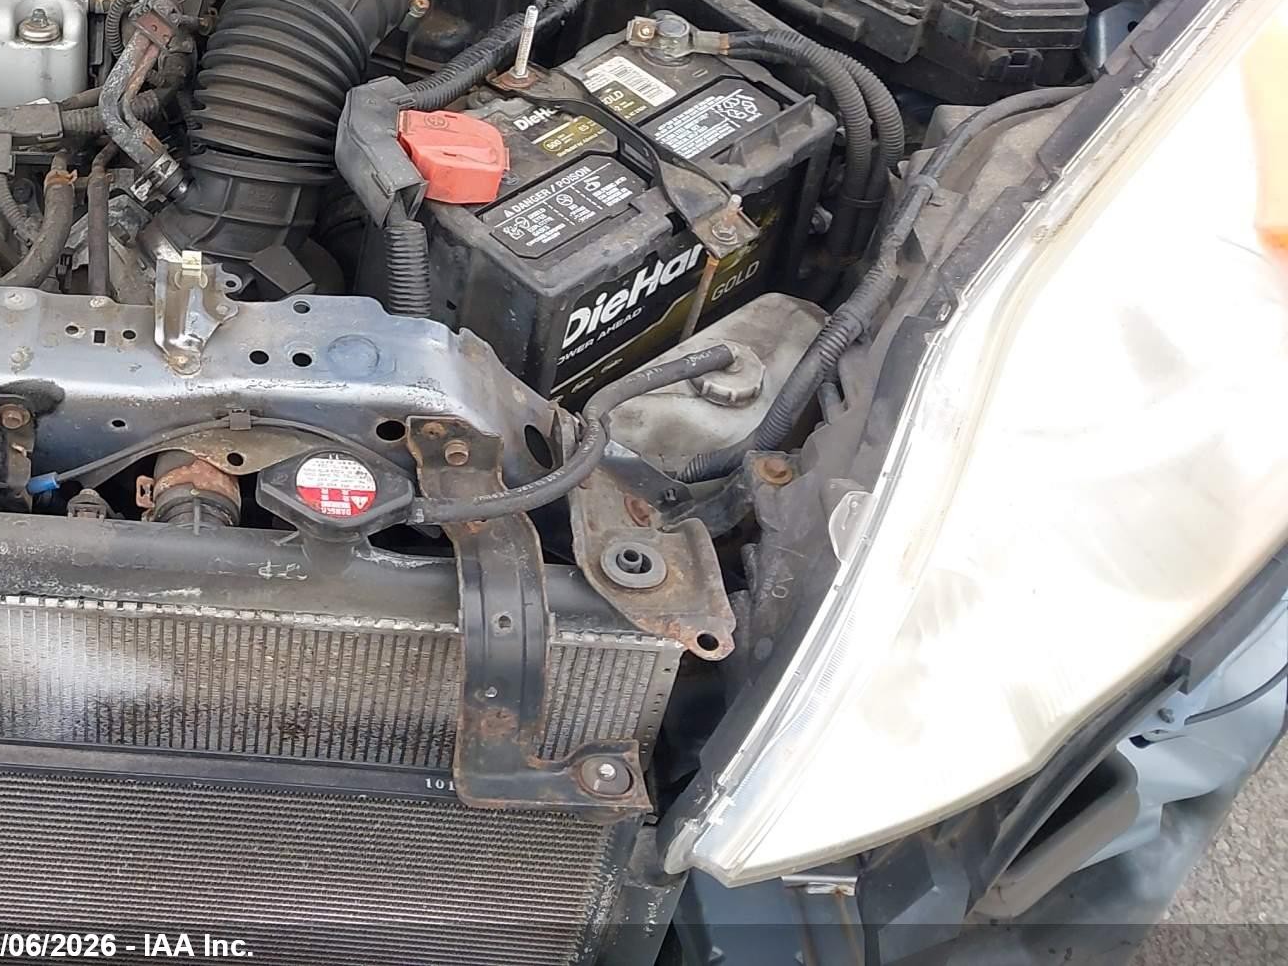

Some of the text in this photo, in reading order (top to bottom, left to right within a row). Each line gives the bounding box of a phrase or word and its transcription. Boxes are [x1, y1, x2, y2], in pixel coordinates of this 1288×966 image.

[511, 185, 551, 214] DANGER
[556, 166, 592, 189] POISON
[561, 242, 705, 350] DieHar
[711, 260, 760, 301] GOLD
[557, 307, 643, 365] OWER AHEAD
